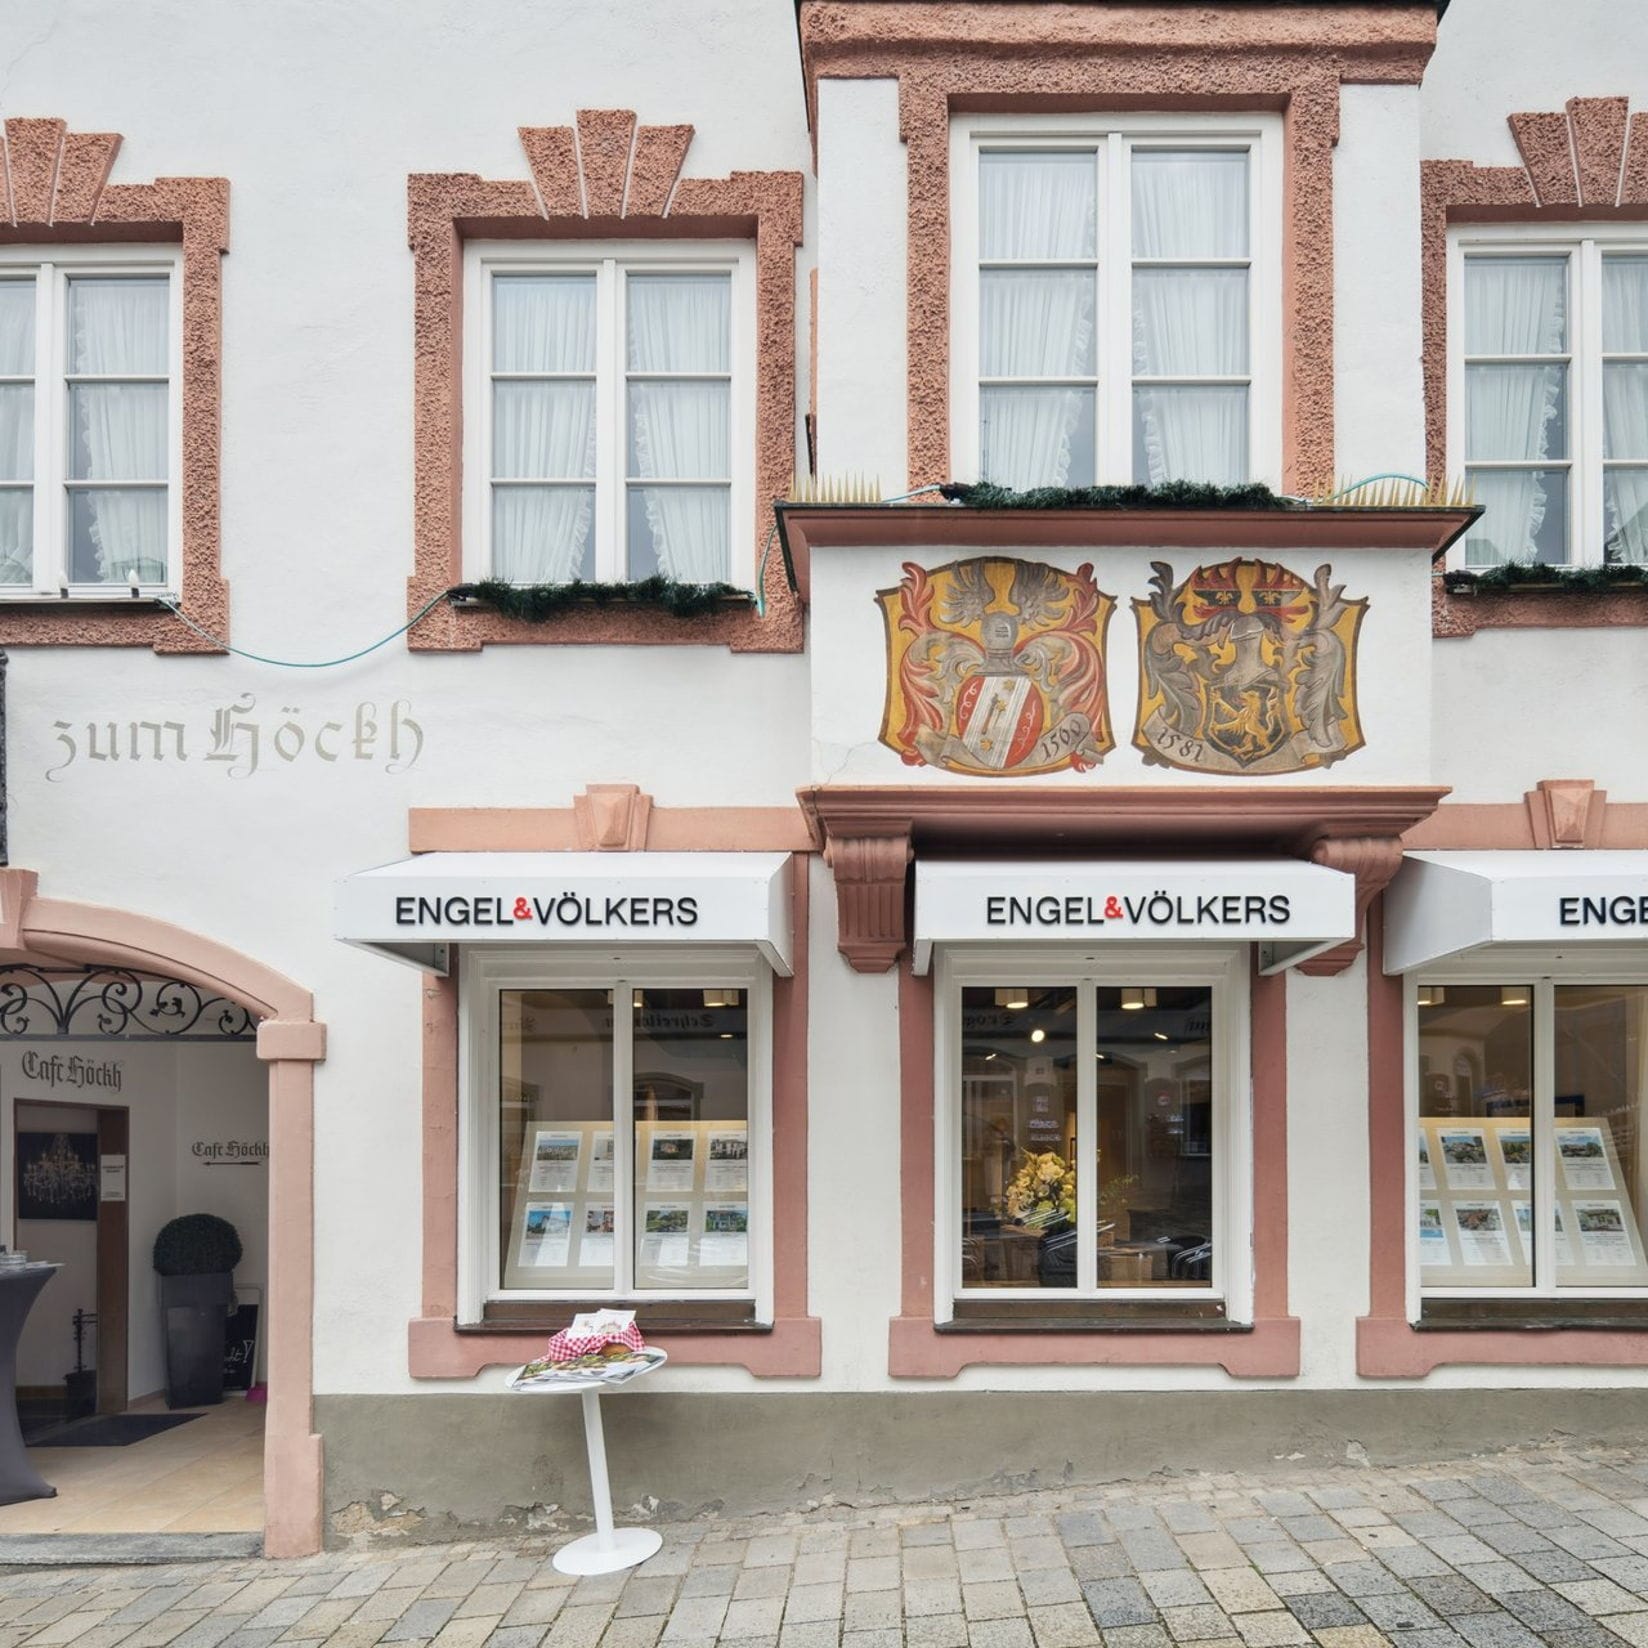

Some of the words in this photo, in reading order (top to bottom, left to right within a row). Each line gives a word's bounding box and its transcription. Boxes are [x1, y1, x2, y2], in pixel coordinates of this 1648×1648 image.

[45, 721, 187, 783] zum
[204, 692, 425, 779] Höckh
[1157, 726, 1203, 763] 1581
[396, 891, 698, 926] ENGEL&VÖLKERS
[987, 890, 1291, 925] ENGEL&VÖLKERS
